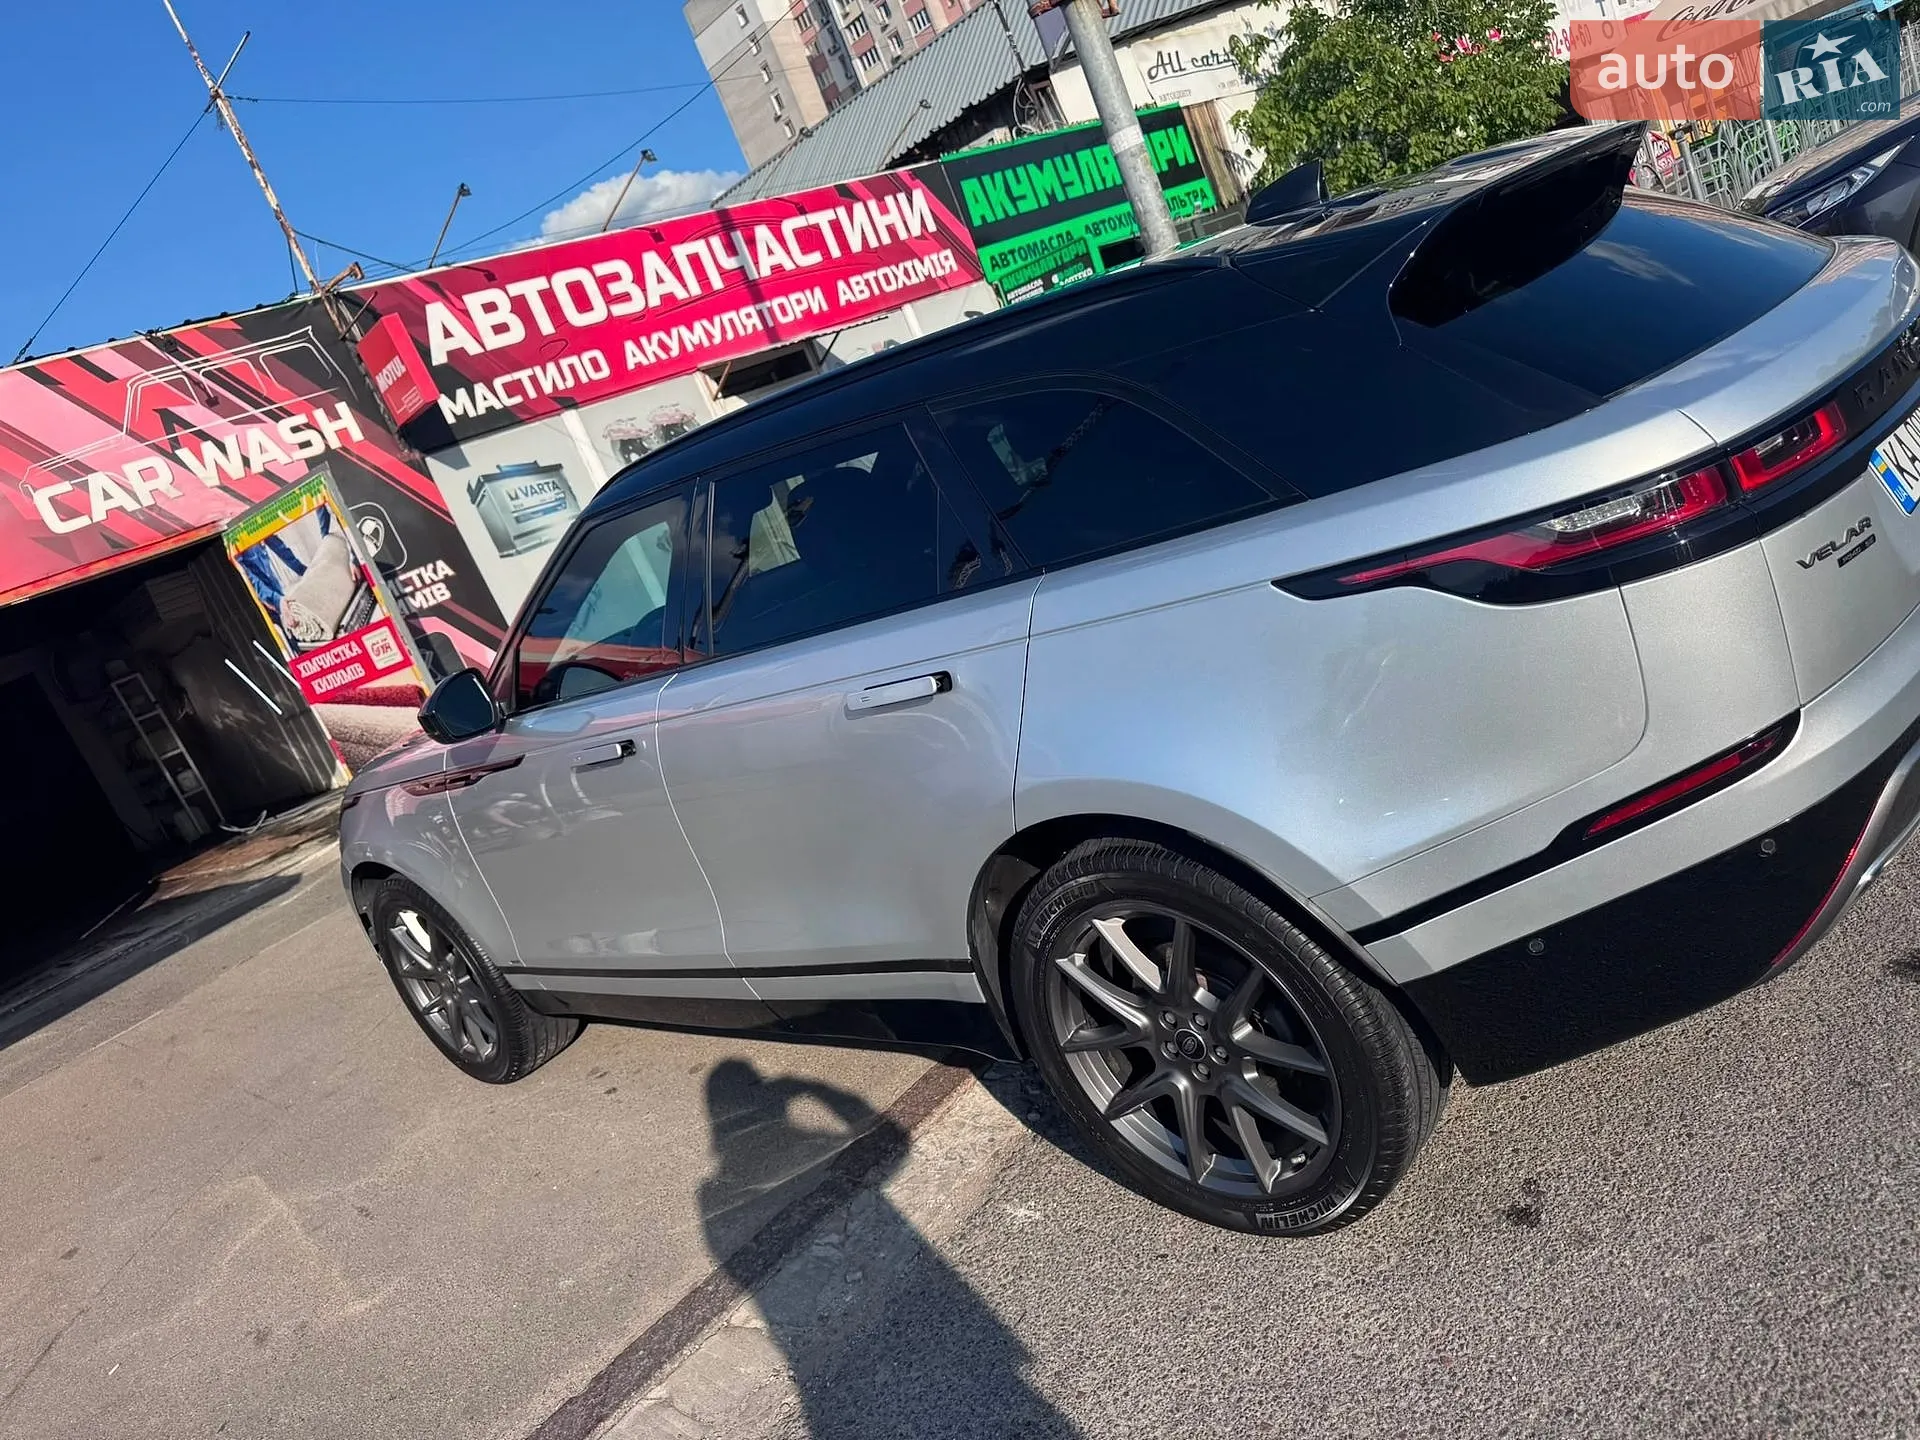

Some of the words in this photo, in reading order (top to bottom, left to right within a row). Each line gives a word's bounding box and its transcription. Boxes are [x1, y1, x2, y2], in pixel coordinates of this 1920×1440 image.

[960, 124, 1198, 228] АКУМУЛЯРИ
[989, 231, 1075, 272] АВТОМАСЛА
[1166, 187, 1208, 212] ІЛЬТРА
[426, 188, 938, 367] АВТОЗАПЧАСТИНИ
[438, 347, 610, 425] МАСТИЛО
[624, 285, 829, 371] АКУМУЛЯТОРИ
[836, 248, 957, 307] АВТОХІМІЯ
[375, 355, 406, 394] MOTUL
[32, 456, 183, 535] CAR
[175, 400, 364, 489] WASH
[519, 480, 562, 498] VARTA
[1795, 517, 1873, 570] VELAR
[296, 640, 363, 679] ХІМЧИСТКА
[311, 662, 366, 695] КИЛИМІВ
[1035, 881, 1097, 931] MICHELIN
[1260, 1194, 1338, 1230] MICHELIN
